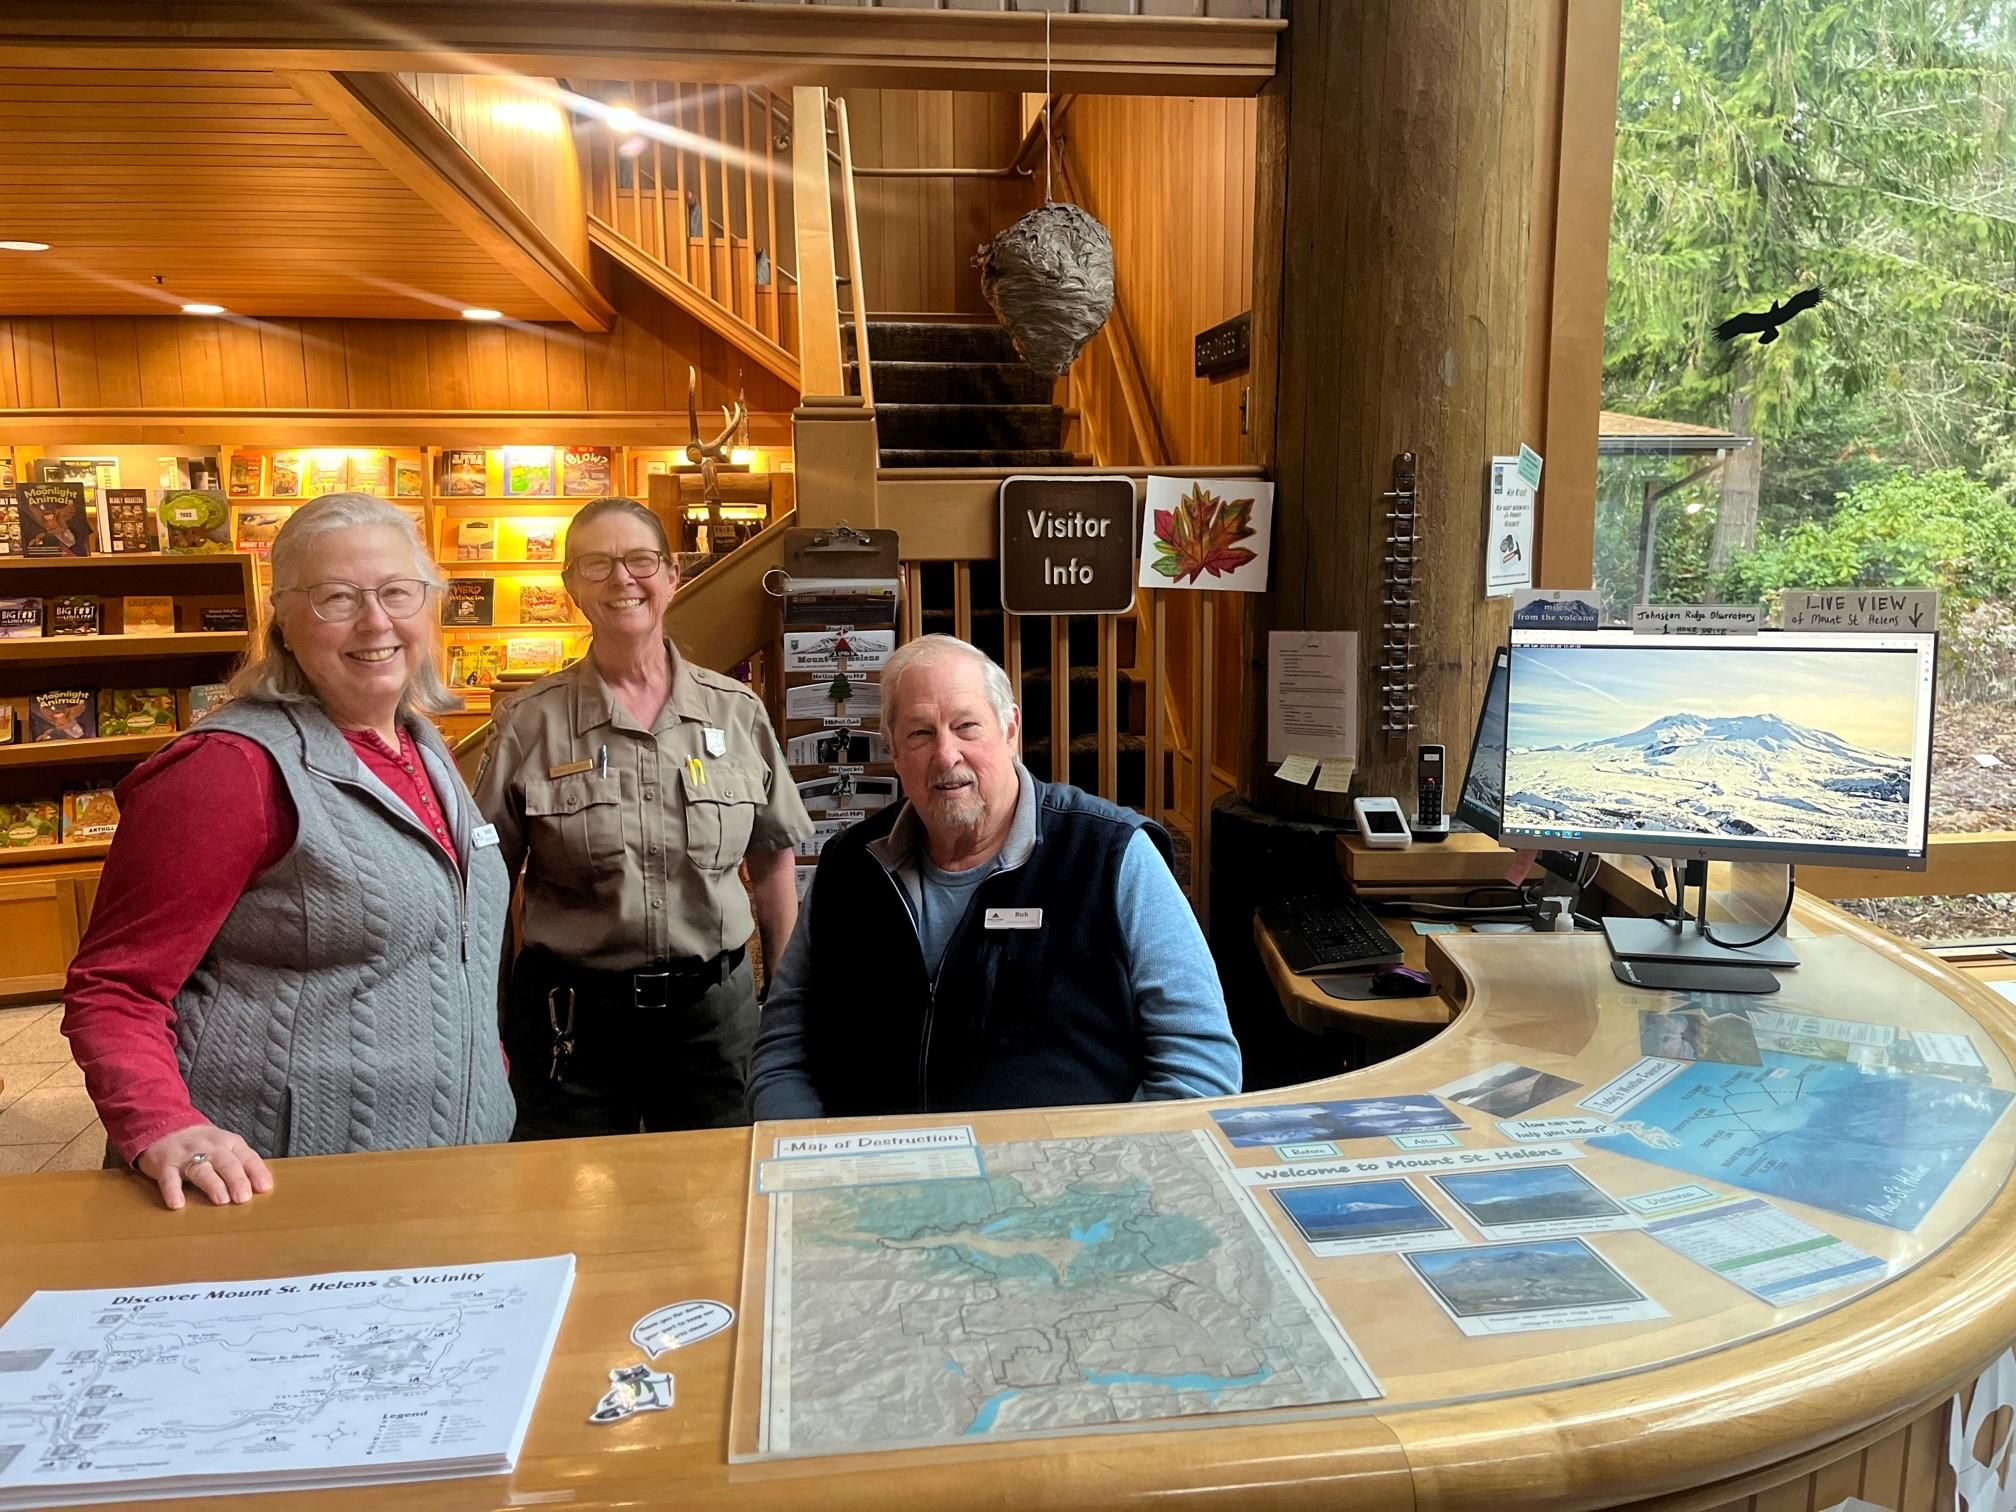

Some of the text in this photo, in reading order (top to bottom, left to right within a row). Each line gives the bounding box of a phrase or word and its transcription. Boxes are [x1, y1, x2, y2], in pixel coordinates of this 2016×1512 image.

[24, 487, 78, 500] Moonlight
[28, 496, 74, 505] Animals
[1027, 509, 1111, 538] Visitor
[1044, 557, 1094, 585] Info
[1806, 596, 1906, 612] LIVE VIEW
[2, 610, 16, 620] BIG
[56, 606, 71, 616] BIG
[1637, 611, 1681, 621] Johnston
[1517, 612, 1595, 622] from the volcano
[1792, 612, 1899, 626] of Mount St Helens
[36, 691, 89, 703] Moonlight
[40, 699, 85, 708] Animals
[1518, 1121, 1546, 1129] How
[1515, 1131, 1541, 1139] help
[834, 1139, 851, 1149] of
[1256, 1147, 1563, 1180] Welcome to Mount St. Helens
[111, 1272, 485, 1306] Discover Mount St. Helens & Vicinity
[382, 1410, 429, 1420] Legend
